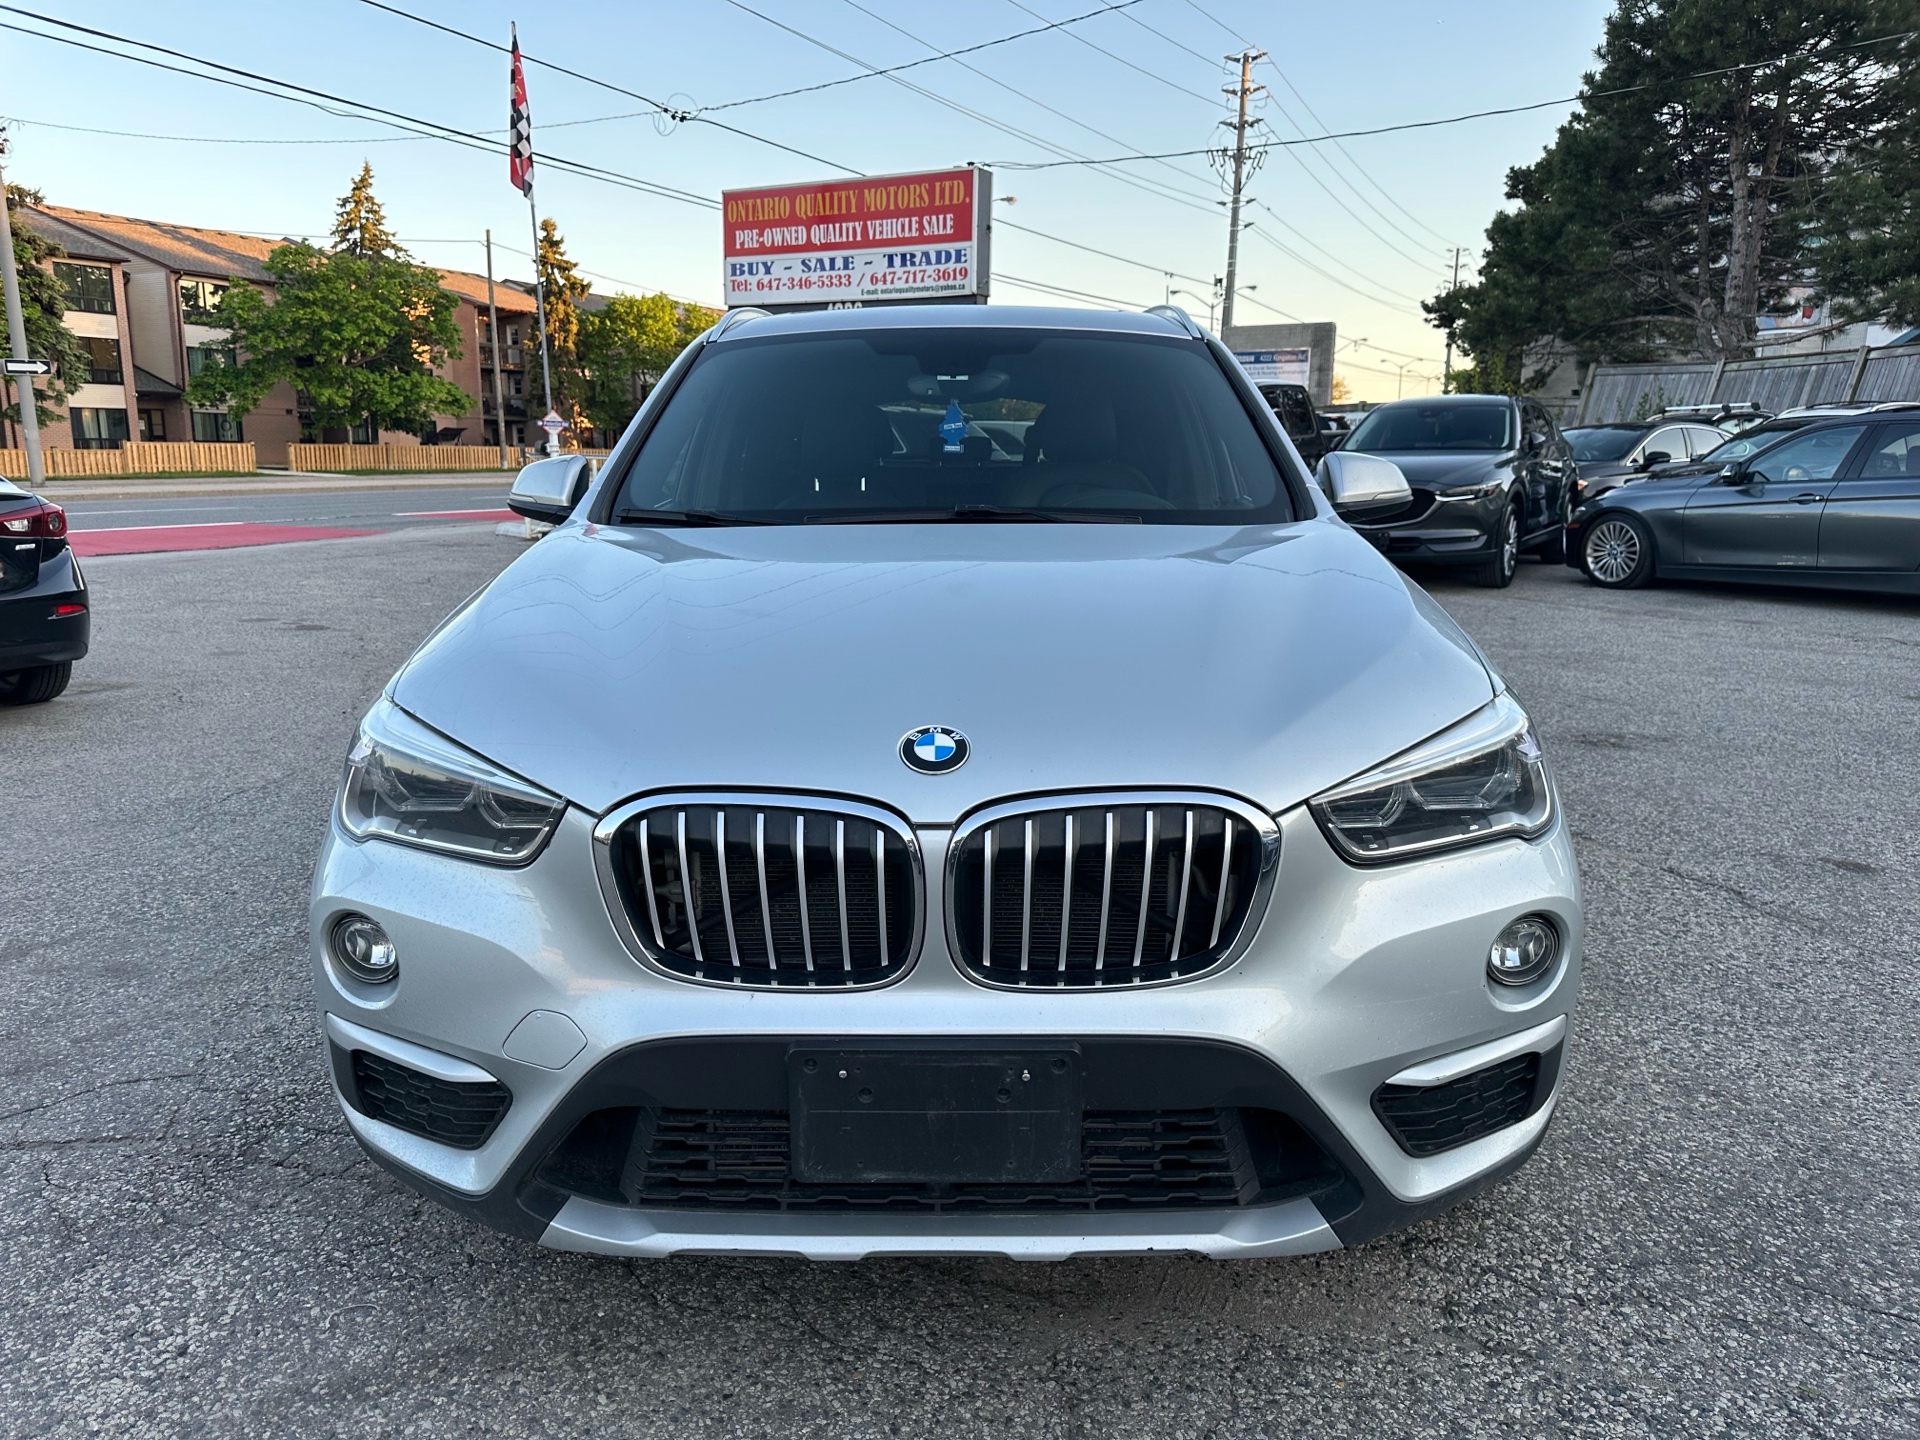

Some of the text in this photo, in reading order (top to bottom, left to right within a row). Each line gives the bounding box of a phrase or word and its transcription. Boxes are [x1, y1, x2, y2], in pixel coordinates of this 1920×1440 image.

[728, 180, 970, 223] ONTARIO QUALITY MOTORS LTD.
[735, 213, 954, 249] PRE-OWNED QUALITY VEHICLE SALE
[730, 260, 775, 277] BUY
[801, 255, 855, 274] SALE
[883, 248, 968, 269] TRADE
[729, 279, 752, 292] Tel:
[756, 273, 852, 291] 647-346-5333
[869, 266, 968, 286] 647-717-3619
[908, 727, 963, 740] BMW
